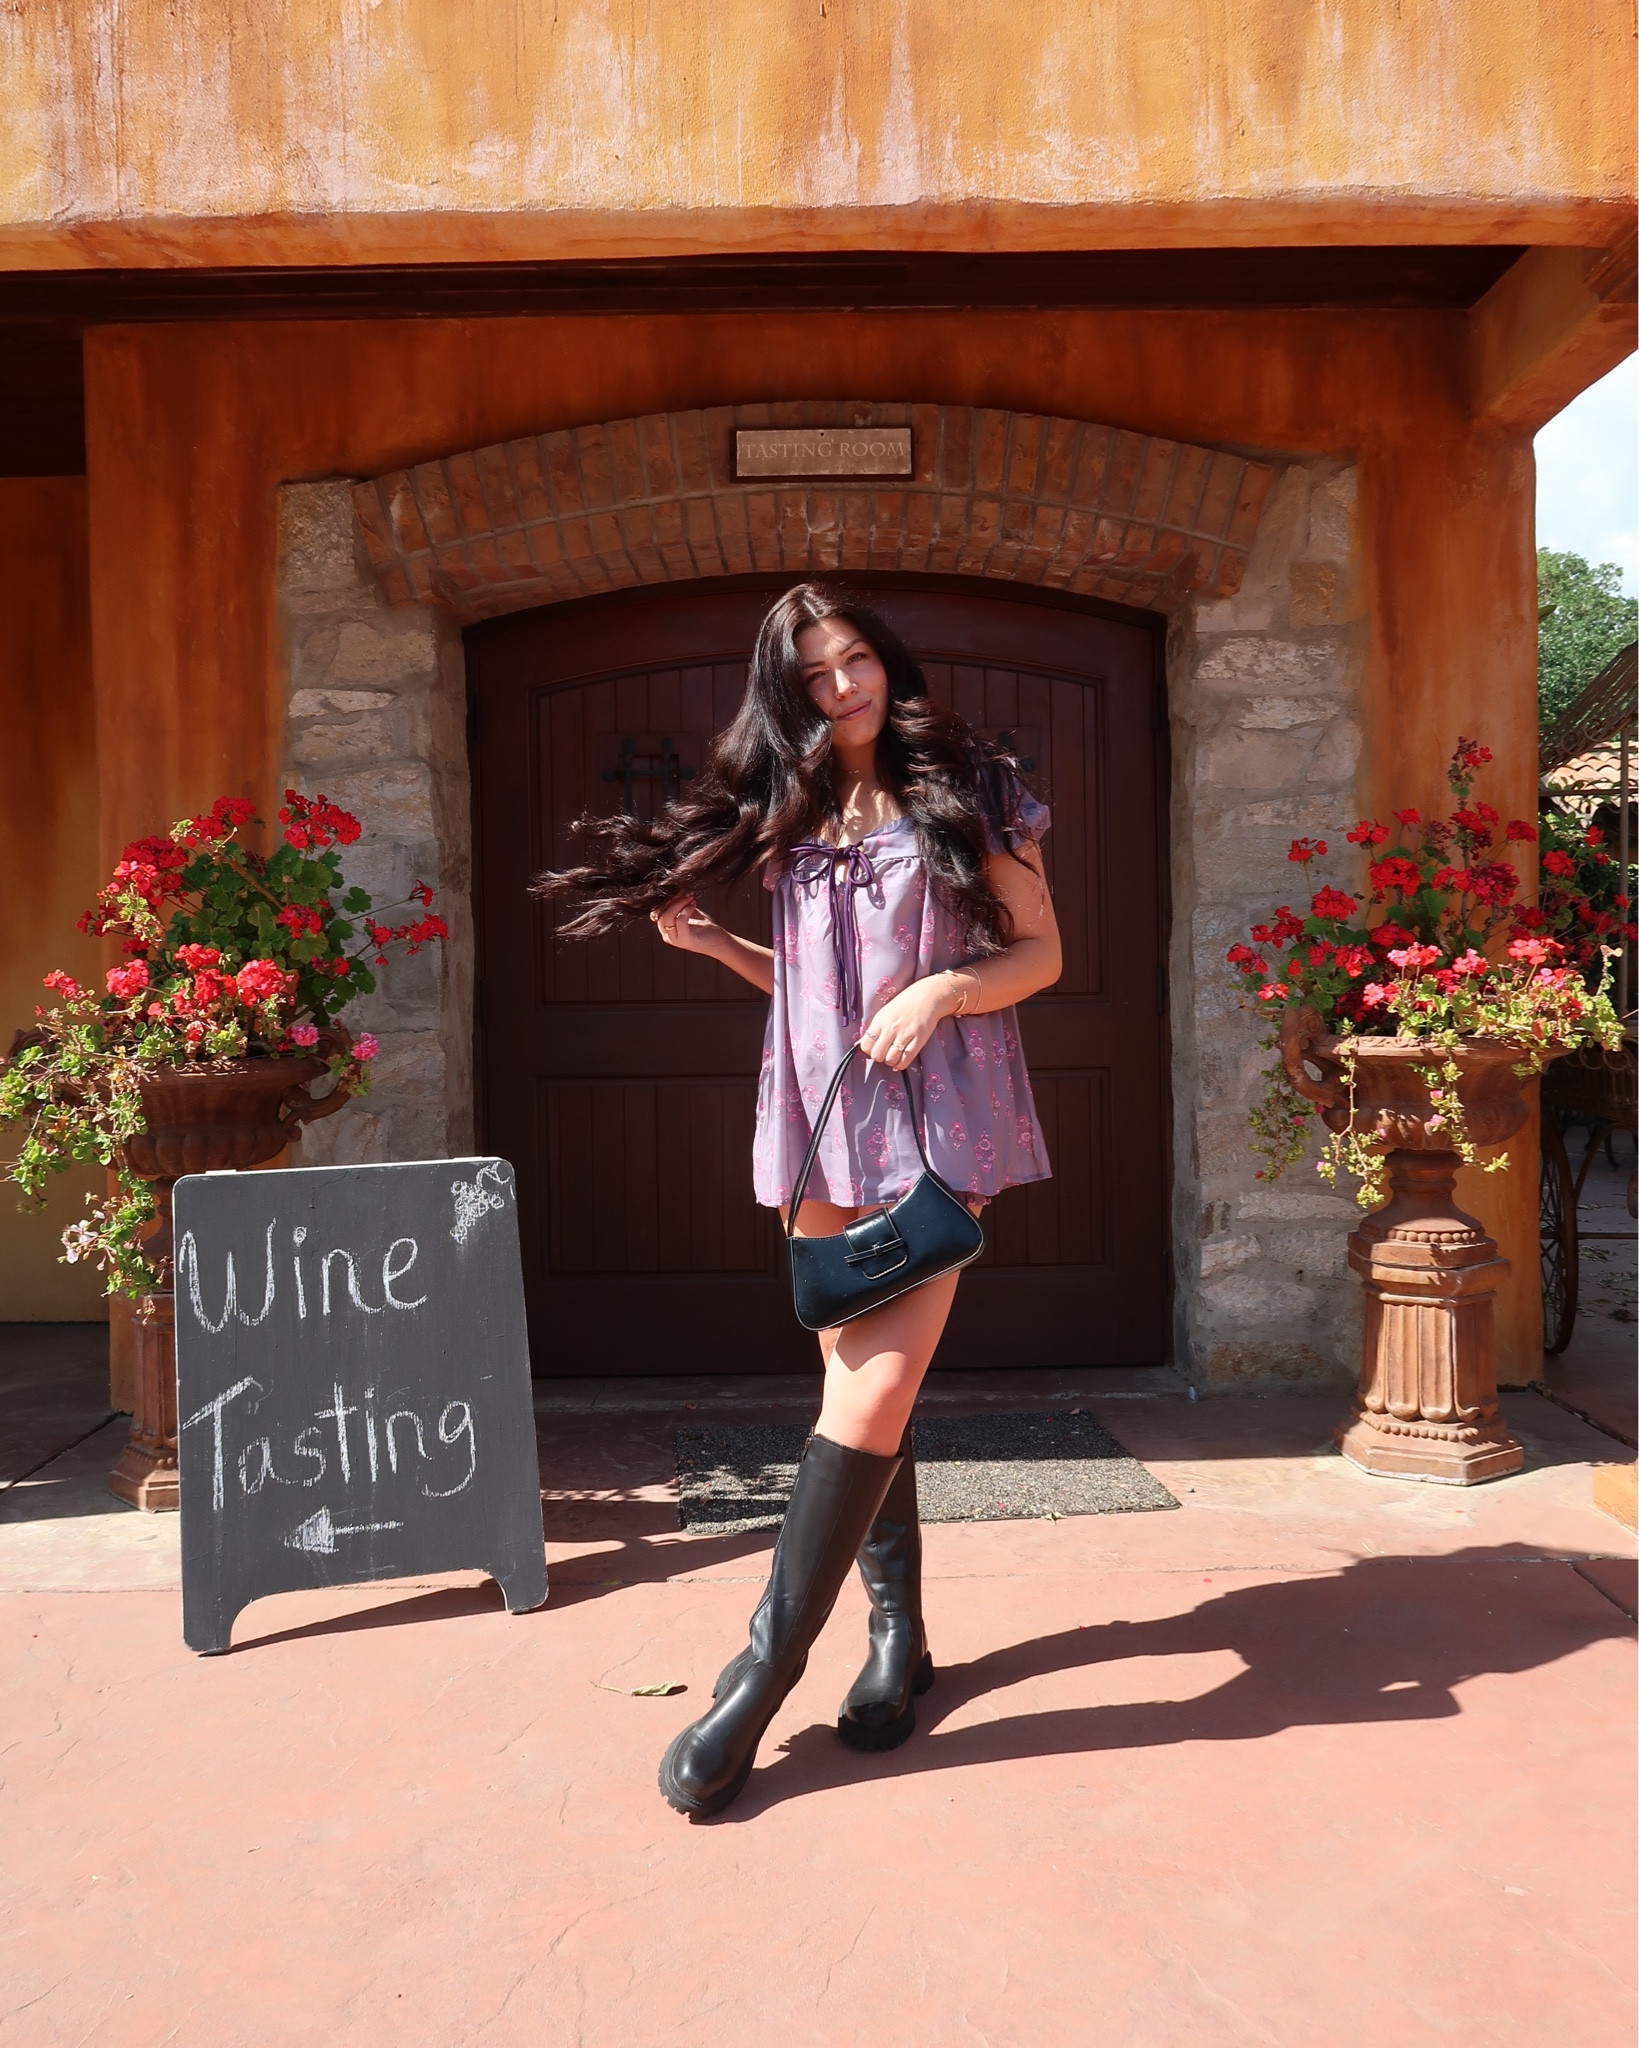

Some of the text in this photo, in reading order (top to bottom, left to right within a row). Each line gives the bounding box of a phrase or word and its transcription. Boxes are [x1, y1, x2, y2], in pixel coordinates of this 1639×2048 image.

[740, 442, 906, 458] TASTING ROOM
[179, 1217, 428, 1333] Wine
[182, 1375, 476, 1511] Tasting
